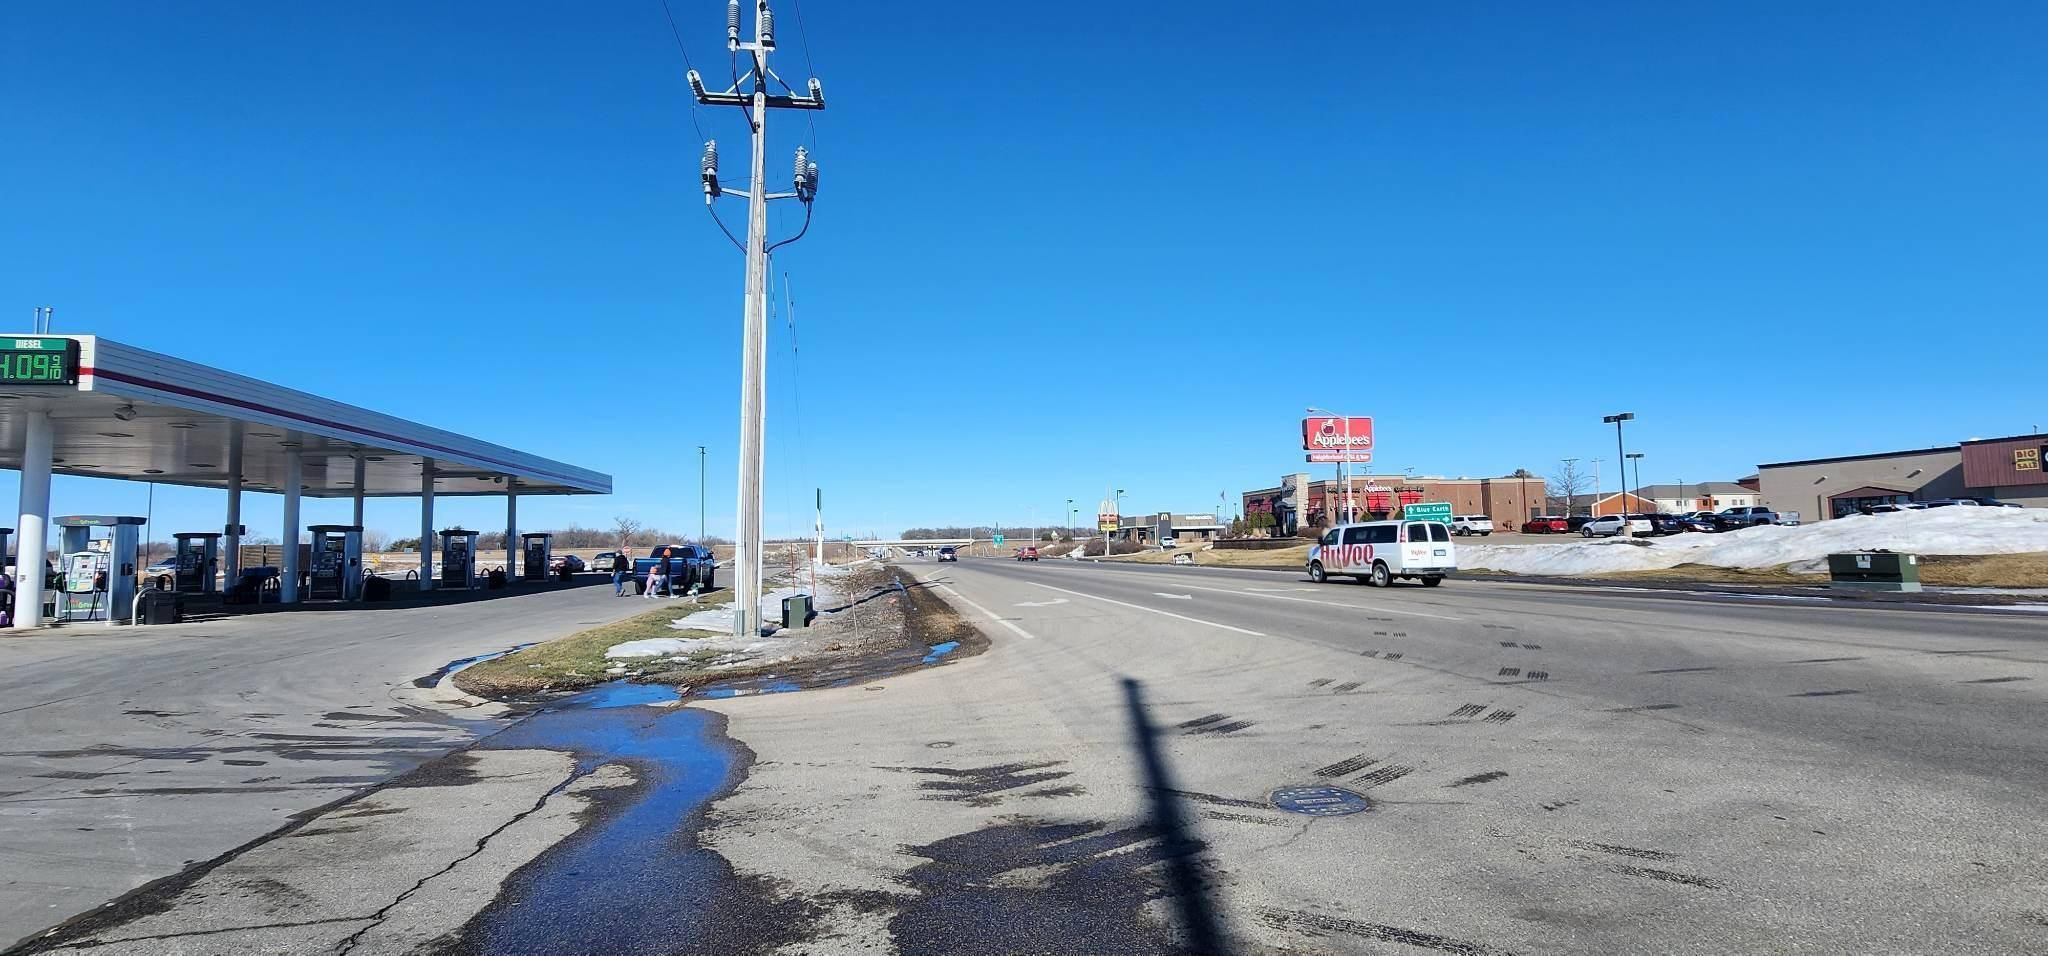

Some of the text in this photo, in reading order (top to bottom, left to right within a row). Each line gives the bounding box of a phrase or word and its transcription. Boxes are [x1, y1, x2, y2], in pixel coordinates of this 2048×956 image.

[15, 339, 43, 349] DIESEL
[1313, 431, 1370, 448] Applebee's
[2016, 450, 2036, 458] BIG
